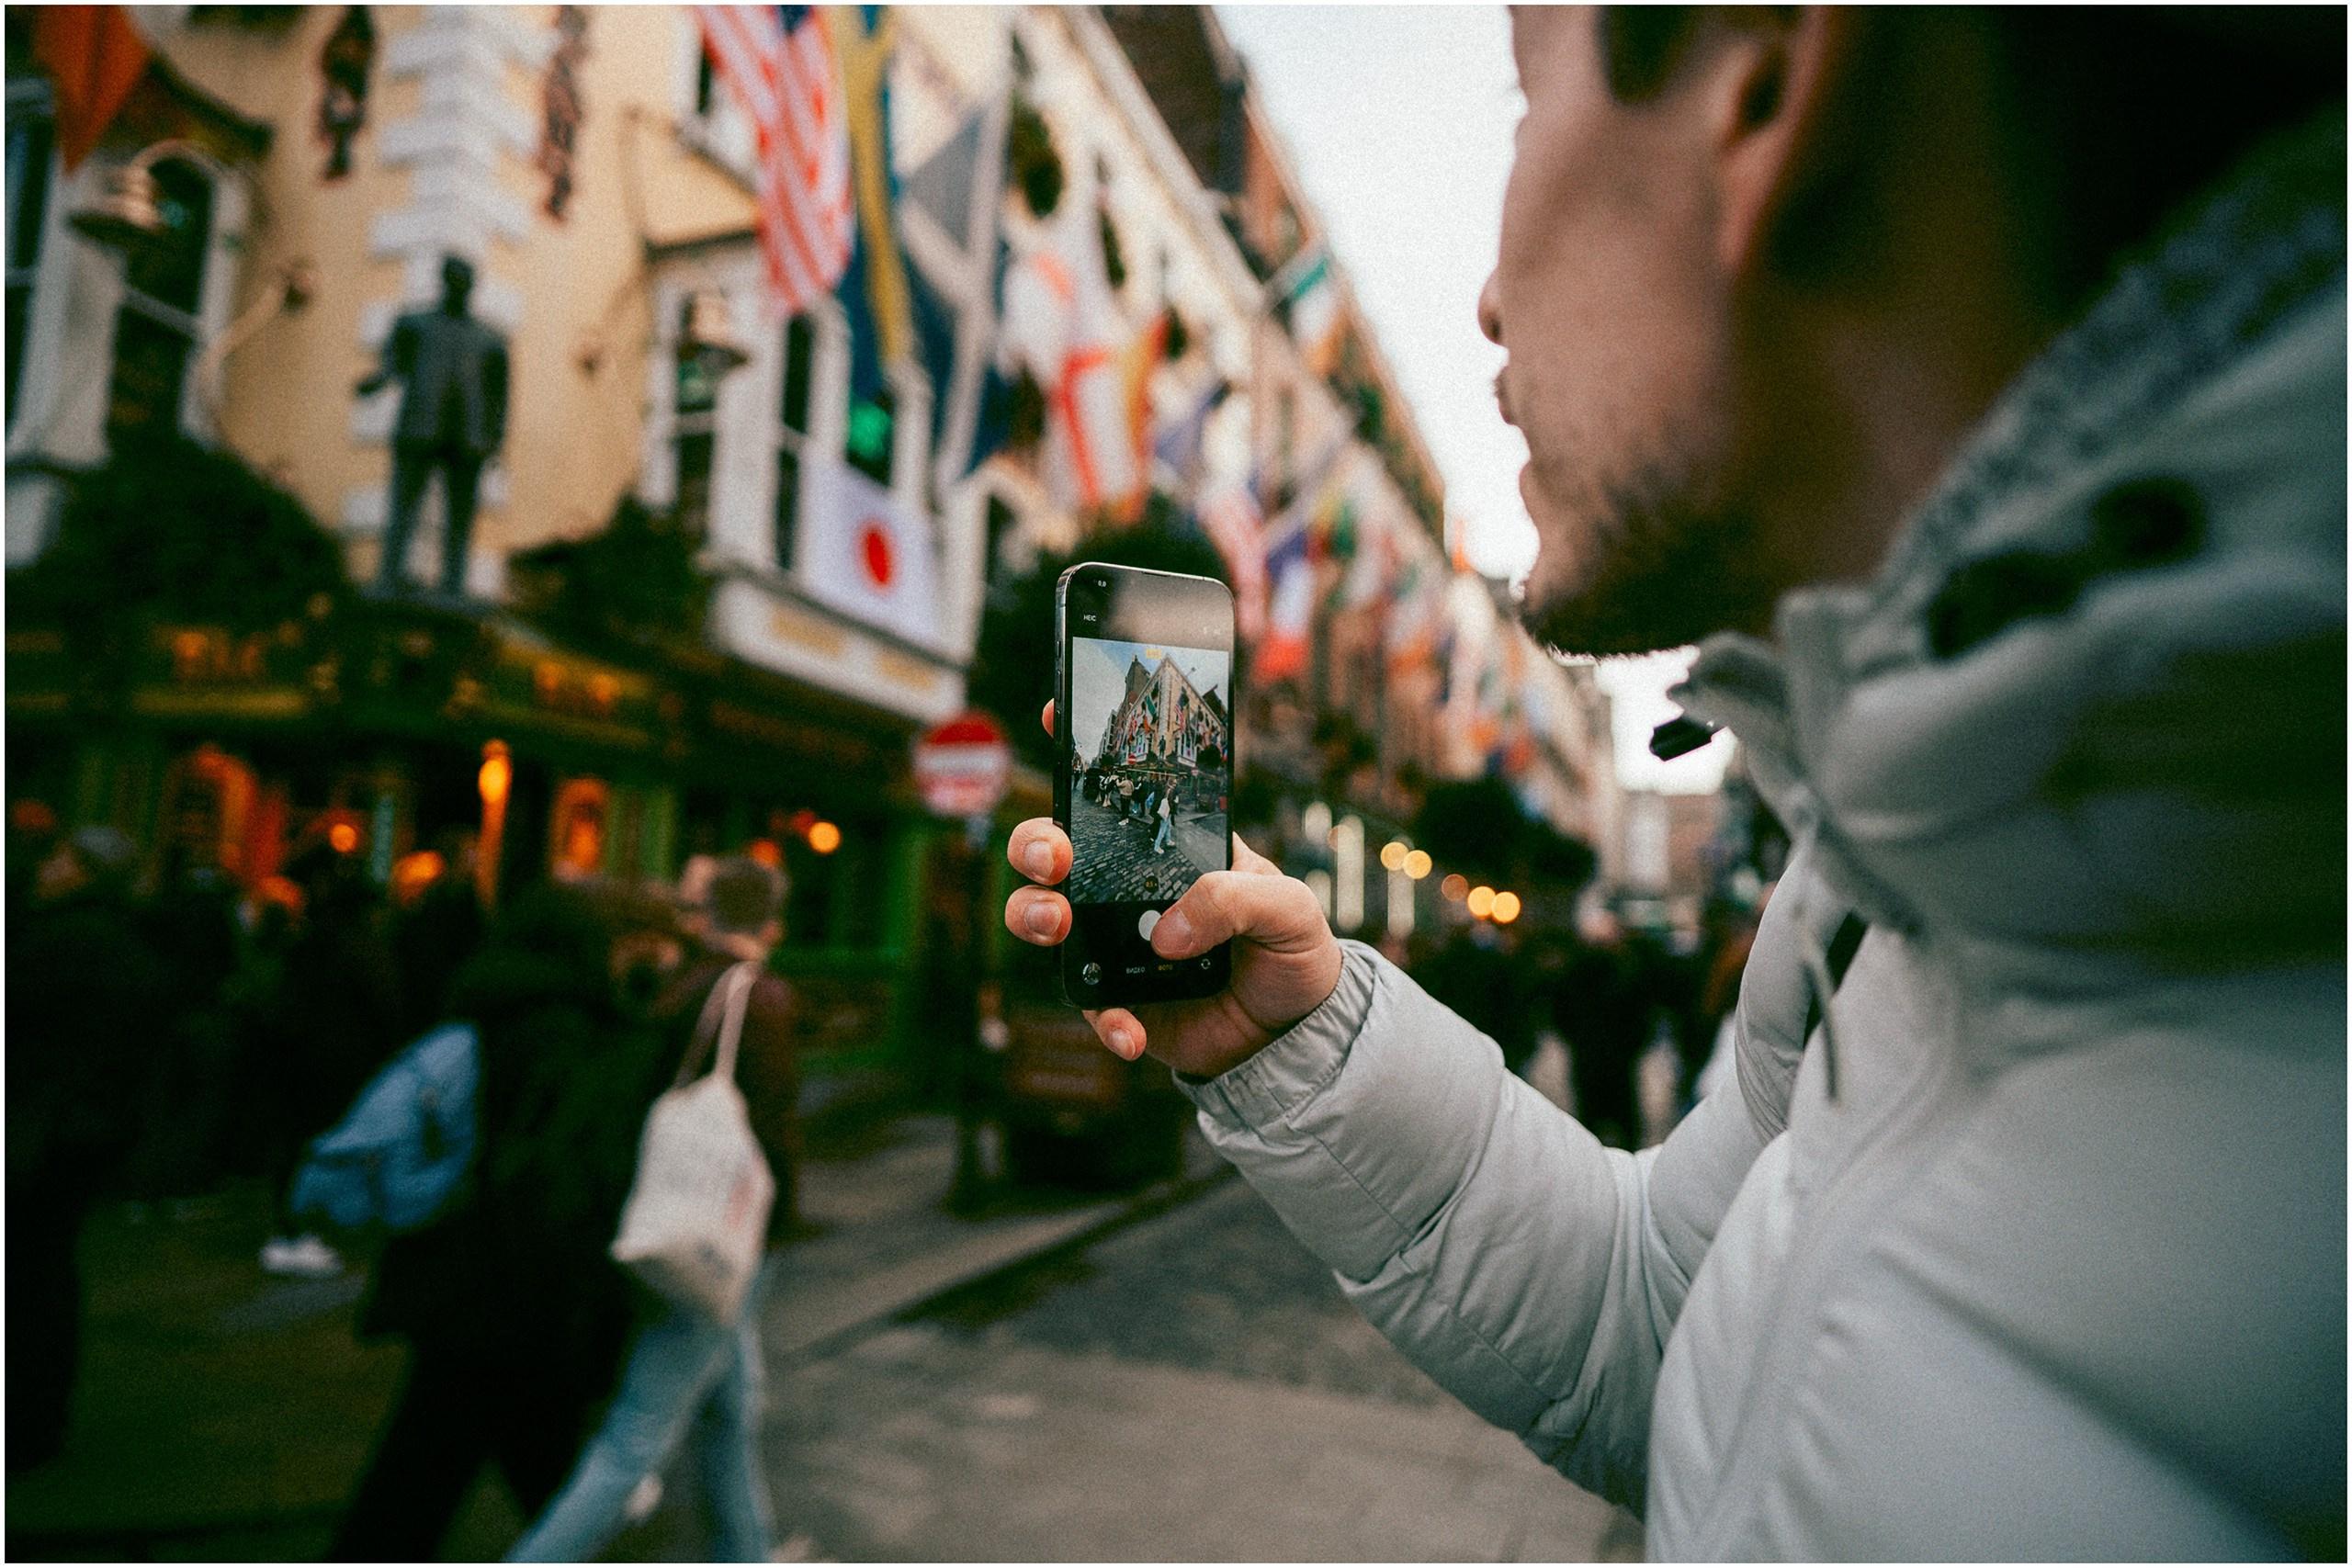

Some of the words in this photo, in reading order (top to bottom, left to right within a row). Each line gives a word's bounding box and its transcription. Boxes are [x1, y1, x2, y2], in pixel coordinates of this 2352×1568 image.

[1083, 614, 1097, 622] HEIC
[1125, 966, 1146, 975] ВИДЕО
[1157, 964, 1174, 972] ФОТО
